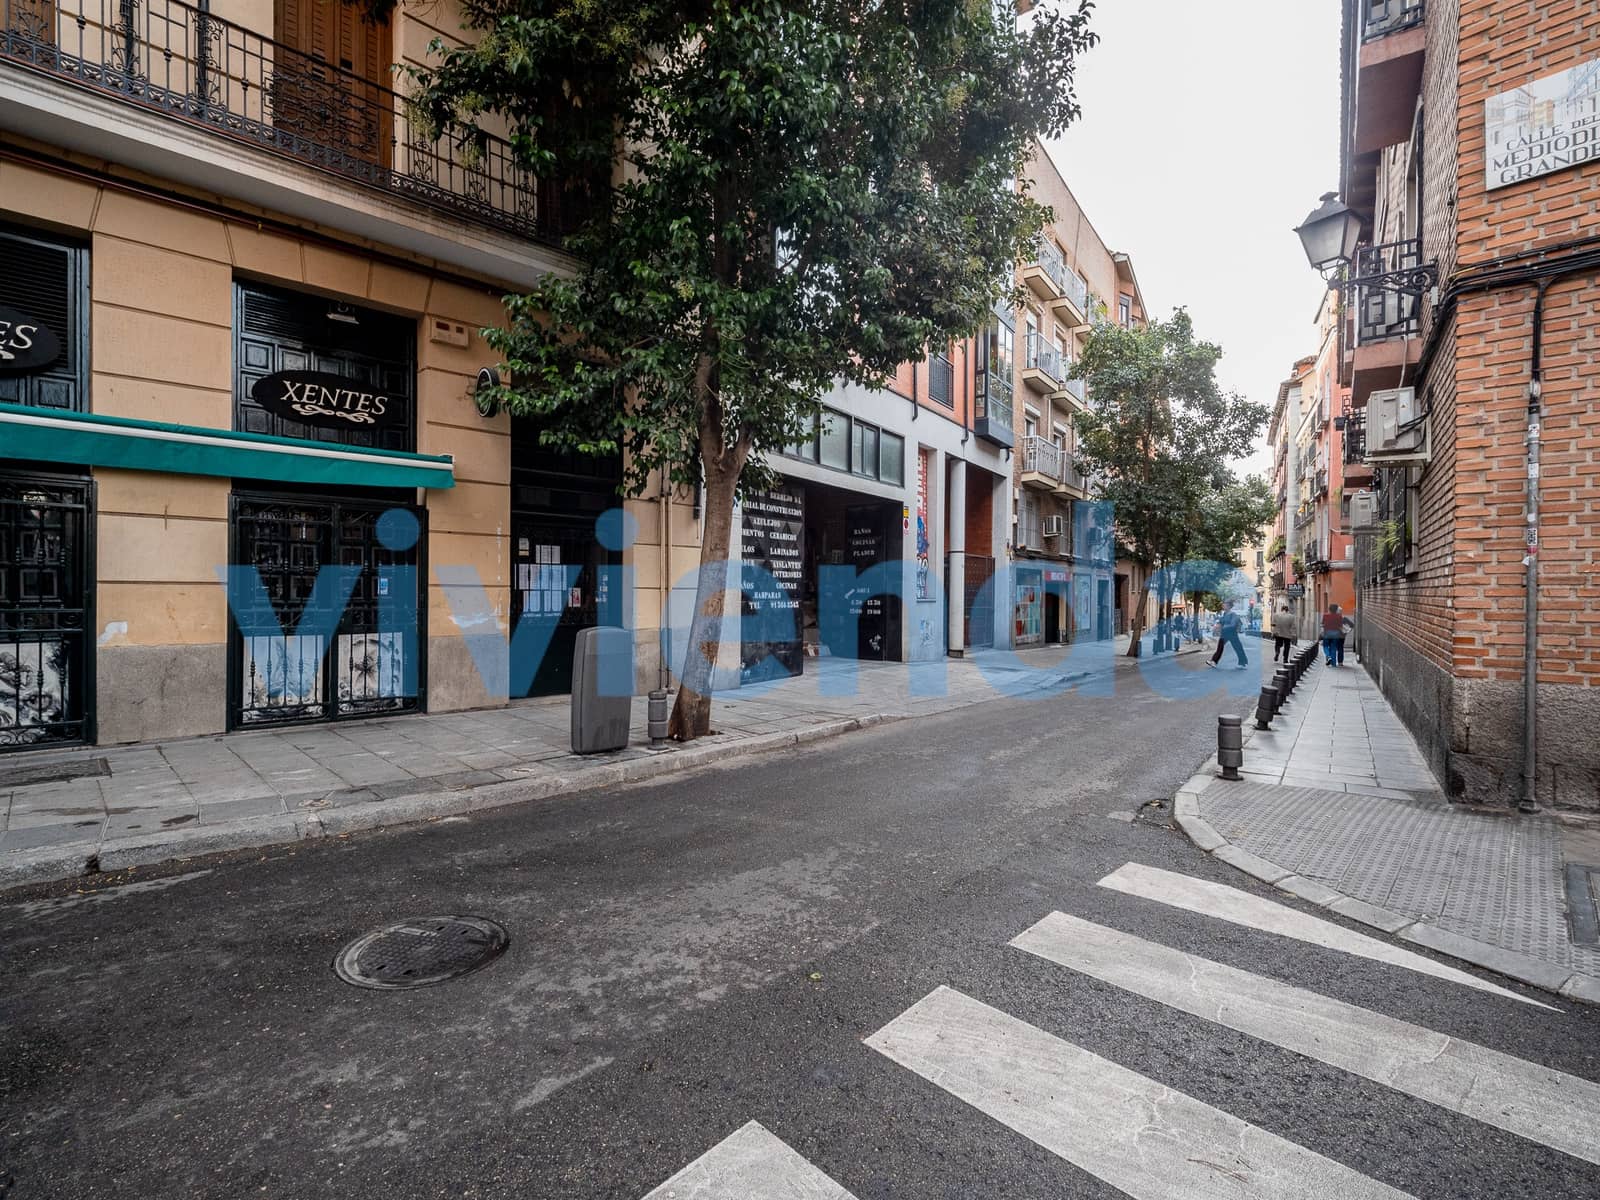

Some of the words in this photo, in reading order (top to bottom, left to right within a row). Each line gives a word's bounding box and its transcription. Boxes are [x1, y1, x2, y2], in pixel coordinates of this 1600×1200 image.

[1506, 123, 1564, 151] CALLE
[1571, 113, 1600, 130] DEL
[1500, 142, 1600, 184] GRANDE
[280, 380, 389, 416] XENTES
[753, 517, 781, 528] AZULEJOS
[769, 546, 799, 557] LAMINADOS
[772, 560, 802, 570] AISLANTES
[772, 570, 802, 579] INTERIORES
[775, 582, 798, 591] COCINAS
